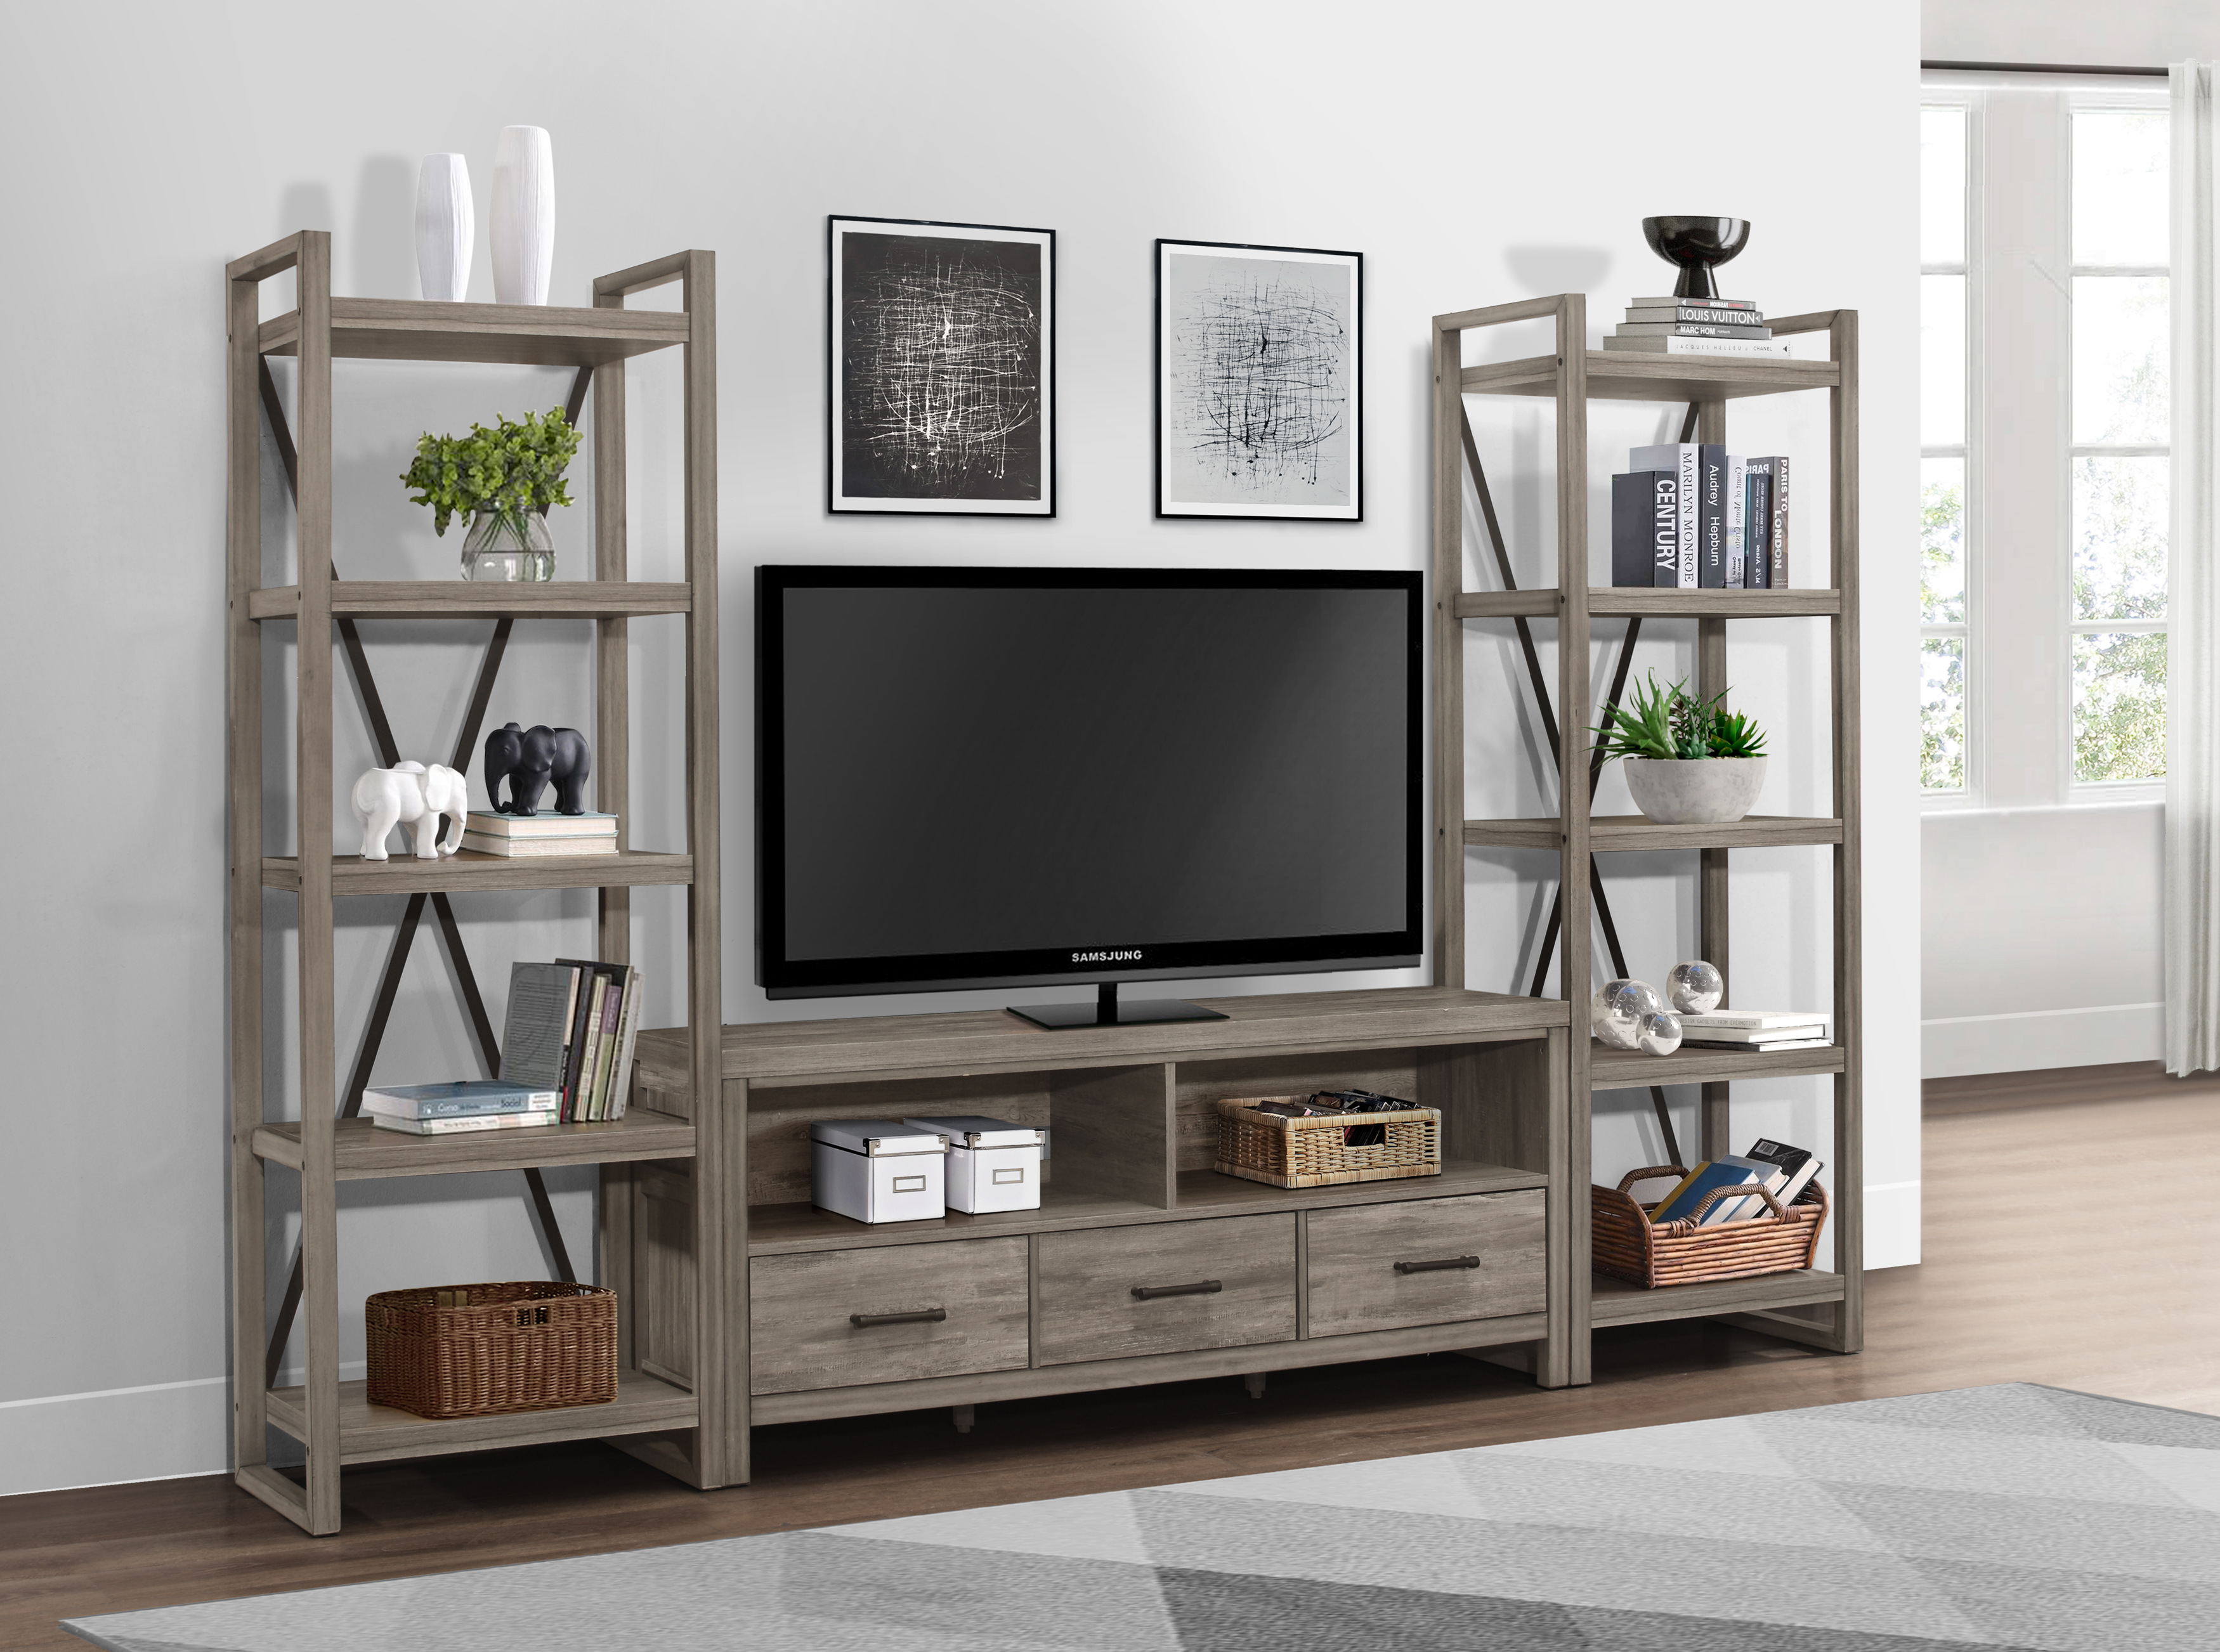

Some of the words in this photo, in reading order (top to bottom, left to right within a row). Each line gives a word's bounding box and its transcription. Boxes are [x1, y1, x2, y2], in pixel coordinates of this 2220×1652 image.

[1680, 325, 1700, 334] MARC
[1701, 327, 1715, 335] HOM
[1681, 309, 1709, 322] LOUIS
[1711, 311, 1755, 325] VUITTON
[1683, 452, 1693, 514] MARILYN
[1708, 465, 1720, 506] Audrey
[1656, 479, 1676, 570] CENTURY
[1781, 497, 1788, 512] TO
[1684, 520, 1694, 582] MONROE
[1709, 517, 1720, 566] Hepburn
[1071, 950, 1142, 963] SAMSJUNG
